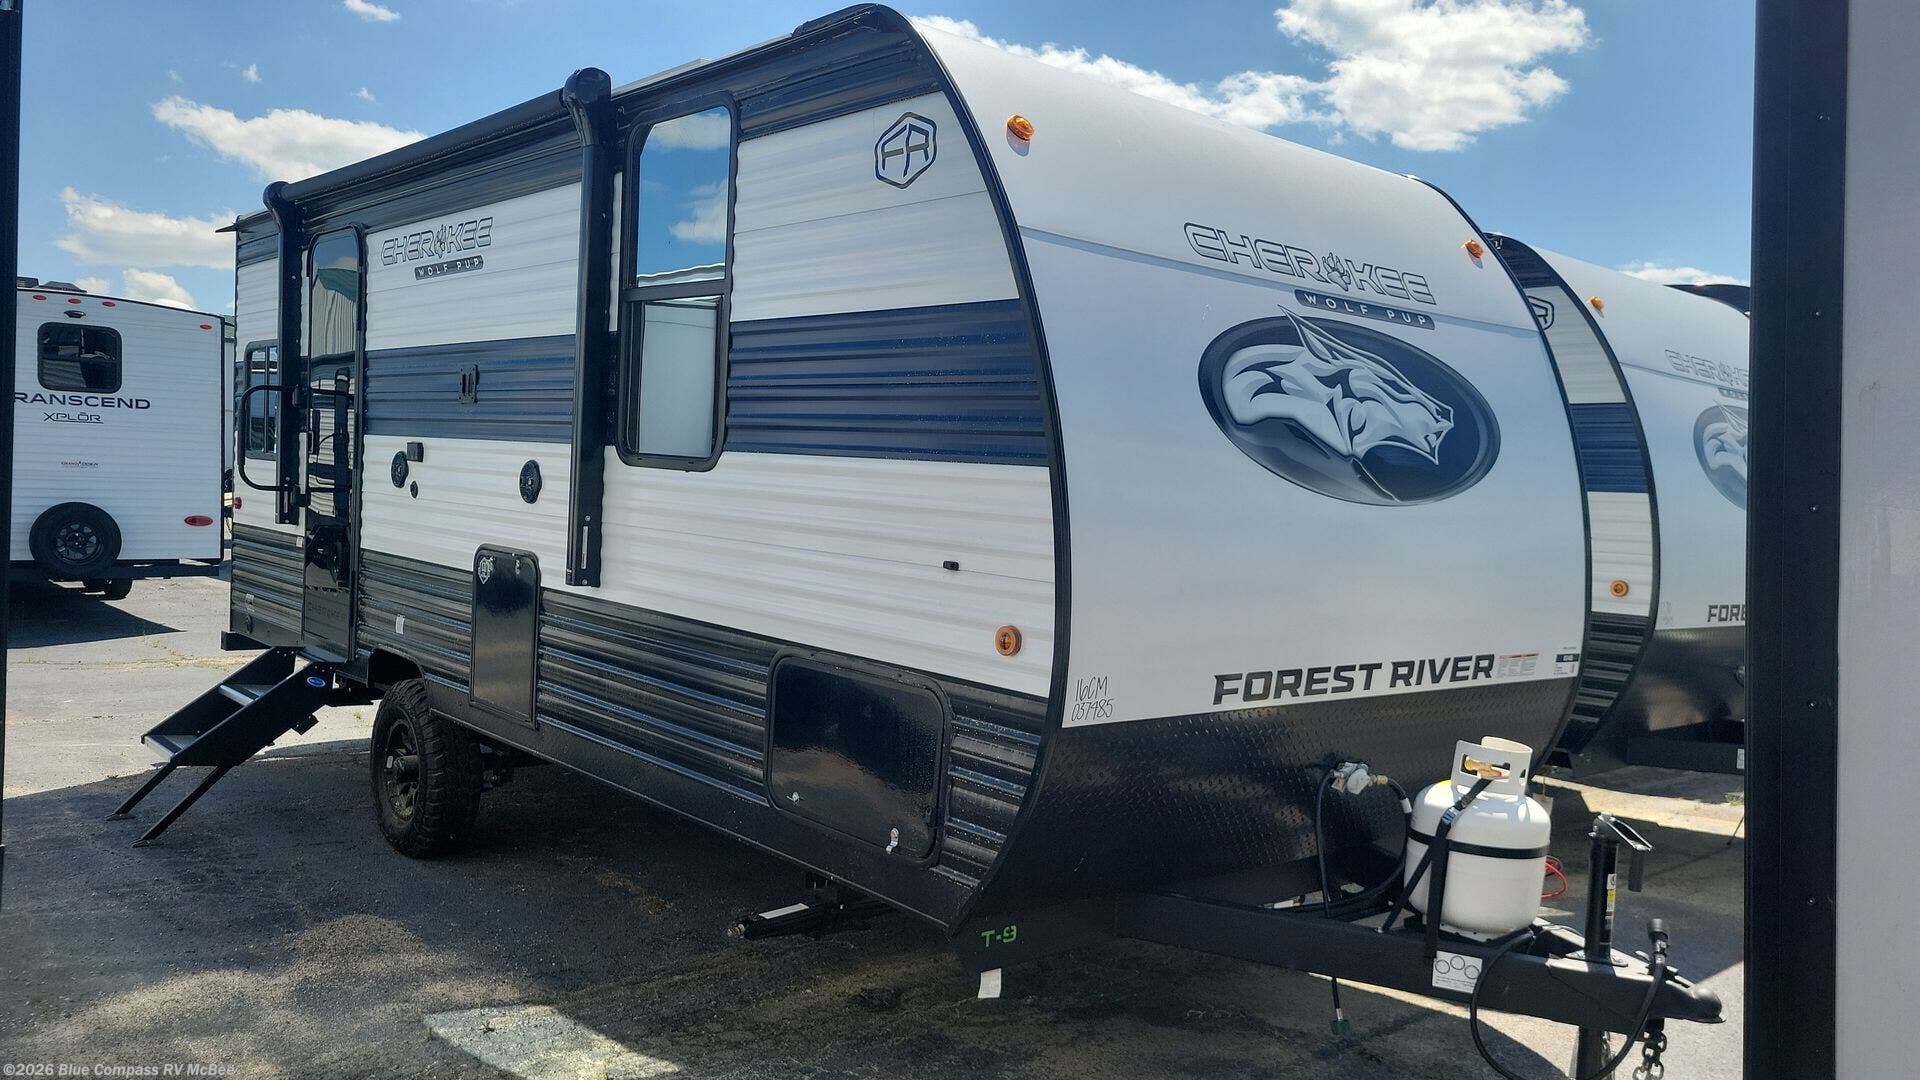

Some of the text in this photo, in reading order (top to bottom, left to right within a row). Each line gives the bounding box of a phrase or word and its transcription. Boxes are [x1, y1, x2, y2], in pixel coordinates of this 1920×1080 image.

[418, 258, 480, 277] WOLF PUP
[1304, 294, 1427, 326] WOLF PUP
[14, 392, 151, 409] RANSCEND
[1213, 663, 1382, 705] FOREST
[1390, 654, 1495, 688] RIVER
[981, 925, 1017, 947] T-9
